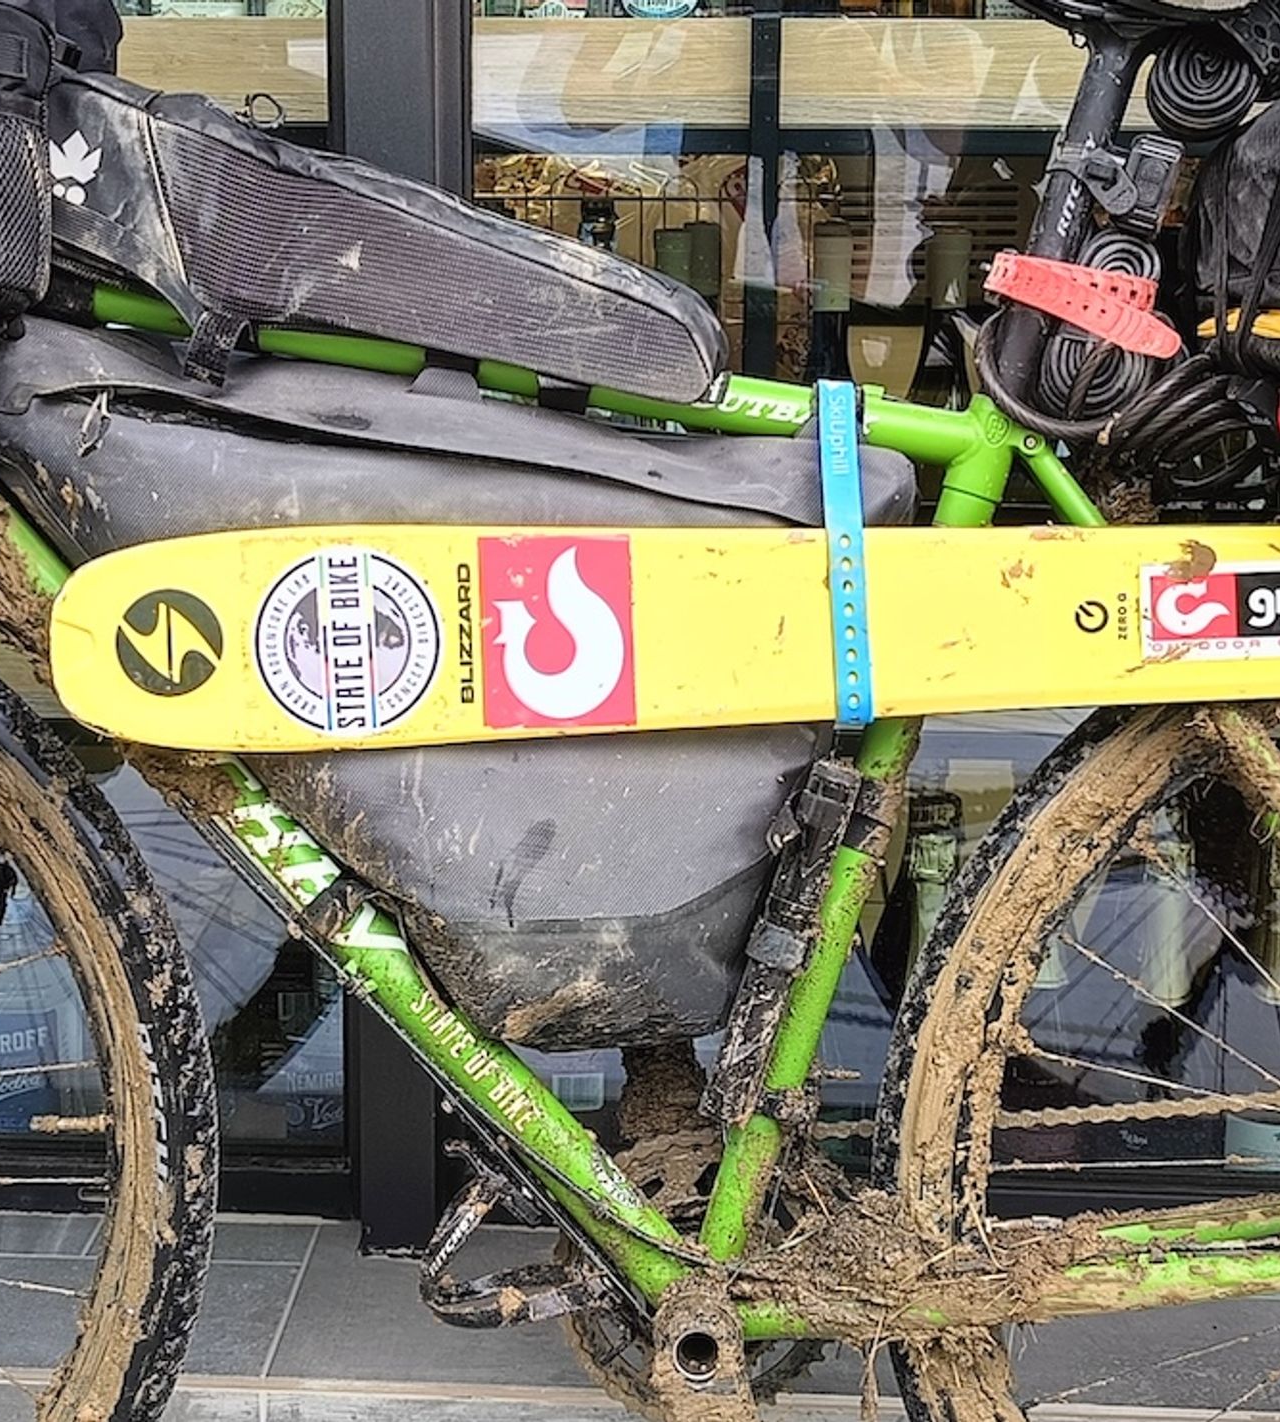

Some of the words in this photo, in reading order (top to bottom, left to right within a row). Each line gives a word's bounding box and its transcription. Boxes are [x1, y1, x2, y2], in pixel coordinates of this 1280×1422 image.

[328, 556, 360, 608] BIKE
[332, 620, 362, 648] OF
[457, 563, 474, 703] BLIZZARD
[1118, 607, 1127, 640] ZERO
[334, 657, 366, 728] STATE
[410, 990, 477, 1059] STATE
[463, 1049, 500, 1083] OF
[487, 1073, 542, 1133] BIKE
